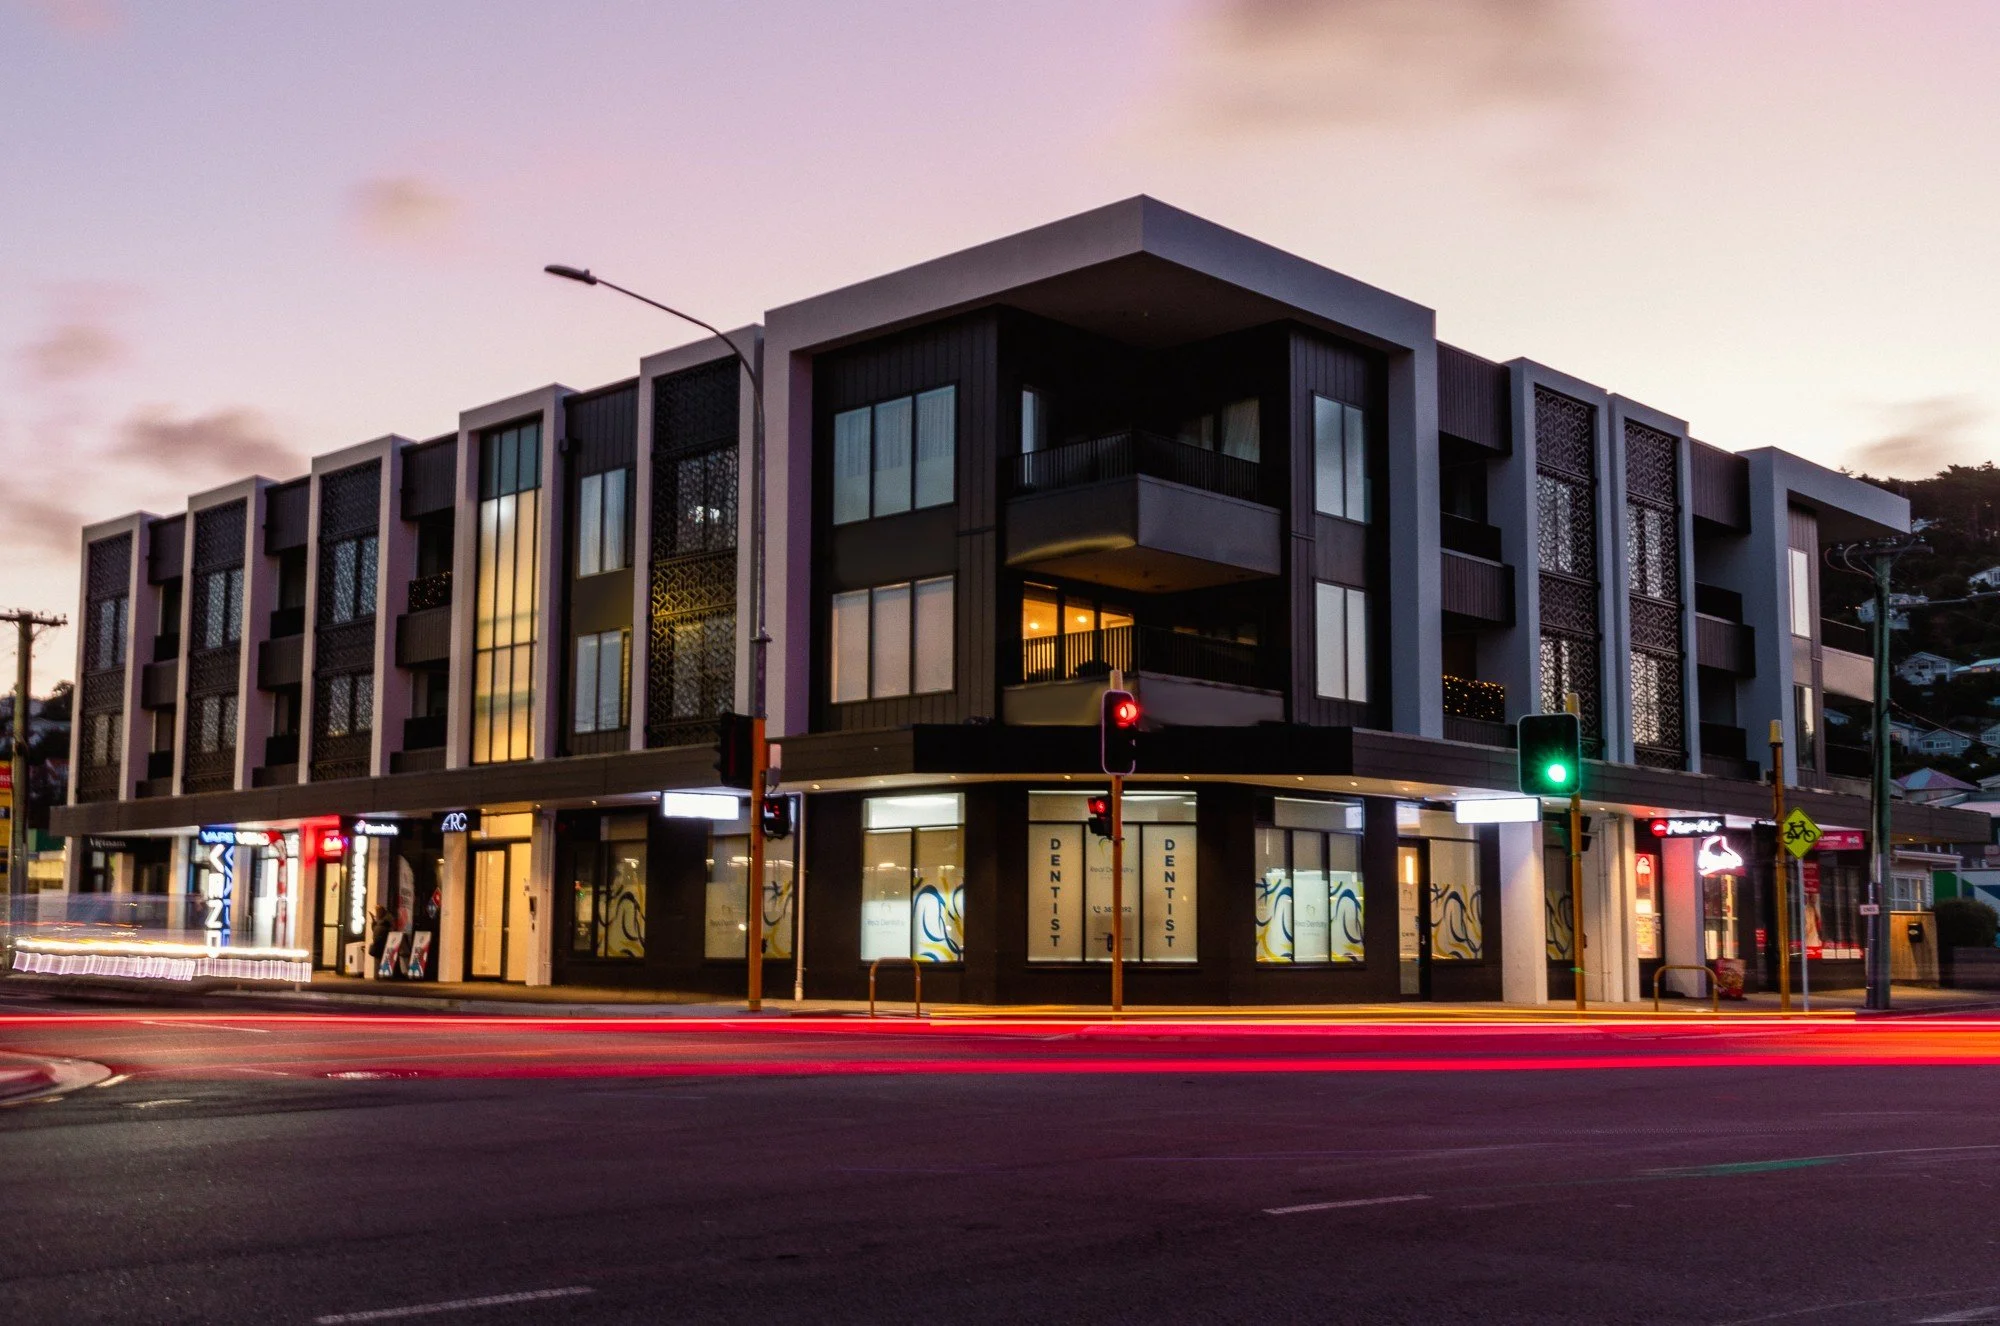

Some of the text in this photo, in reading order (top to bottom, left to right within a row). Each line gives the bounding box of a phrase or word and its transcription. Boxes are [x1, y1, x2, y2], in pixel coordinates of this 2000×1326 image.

[441, 812, 467, 832] ARC
[1050, 838, 1061, 948] DENTIST
[1165, 838, 1176, 948] DENTIST
